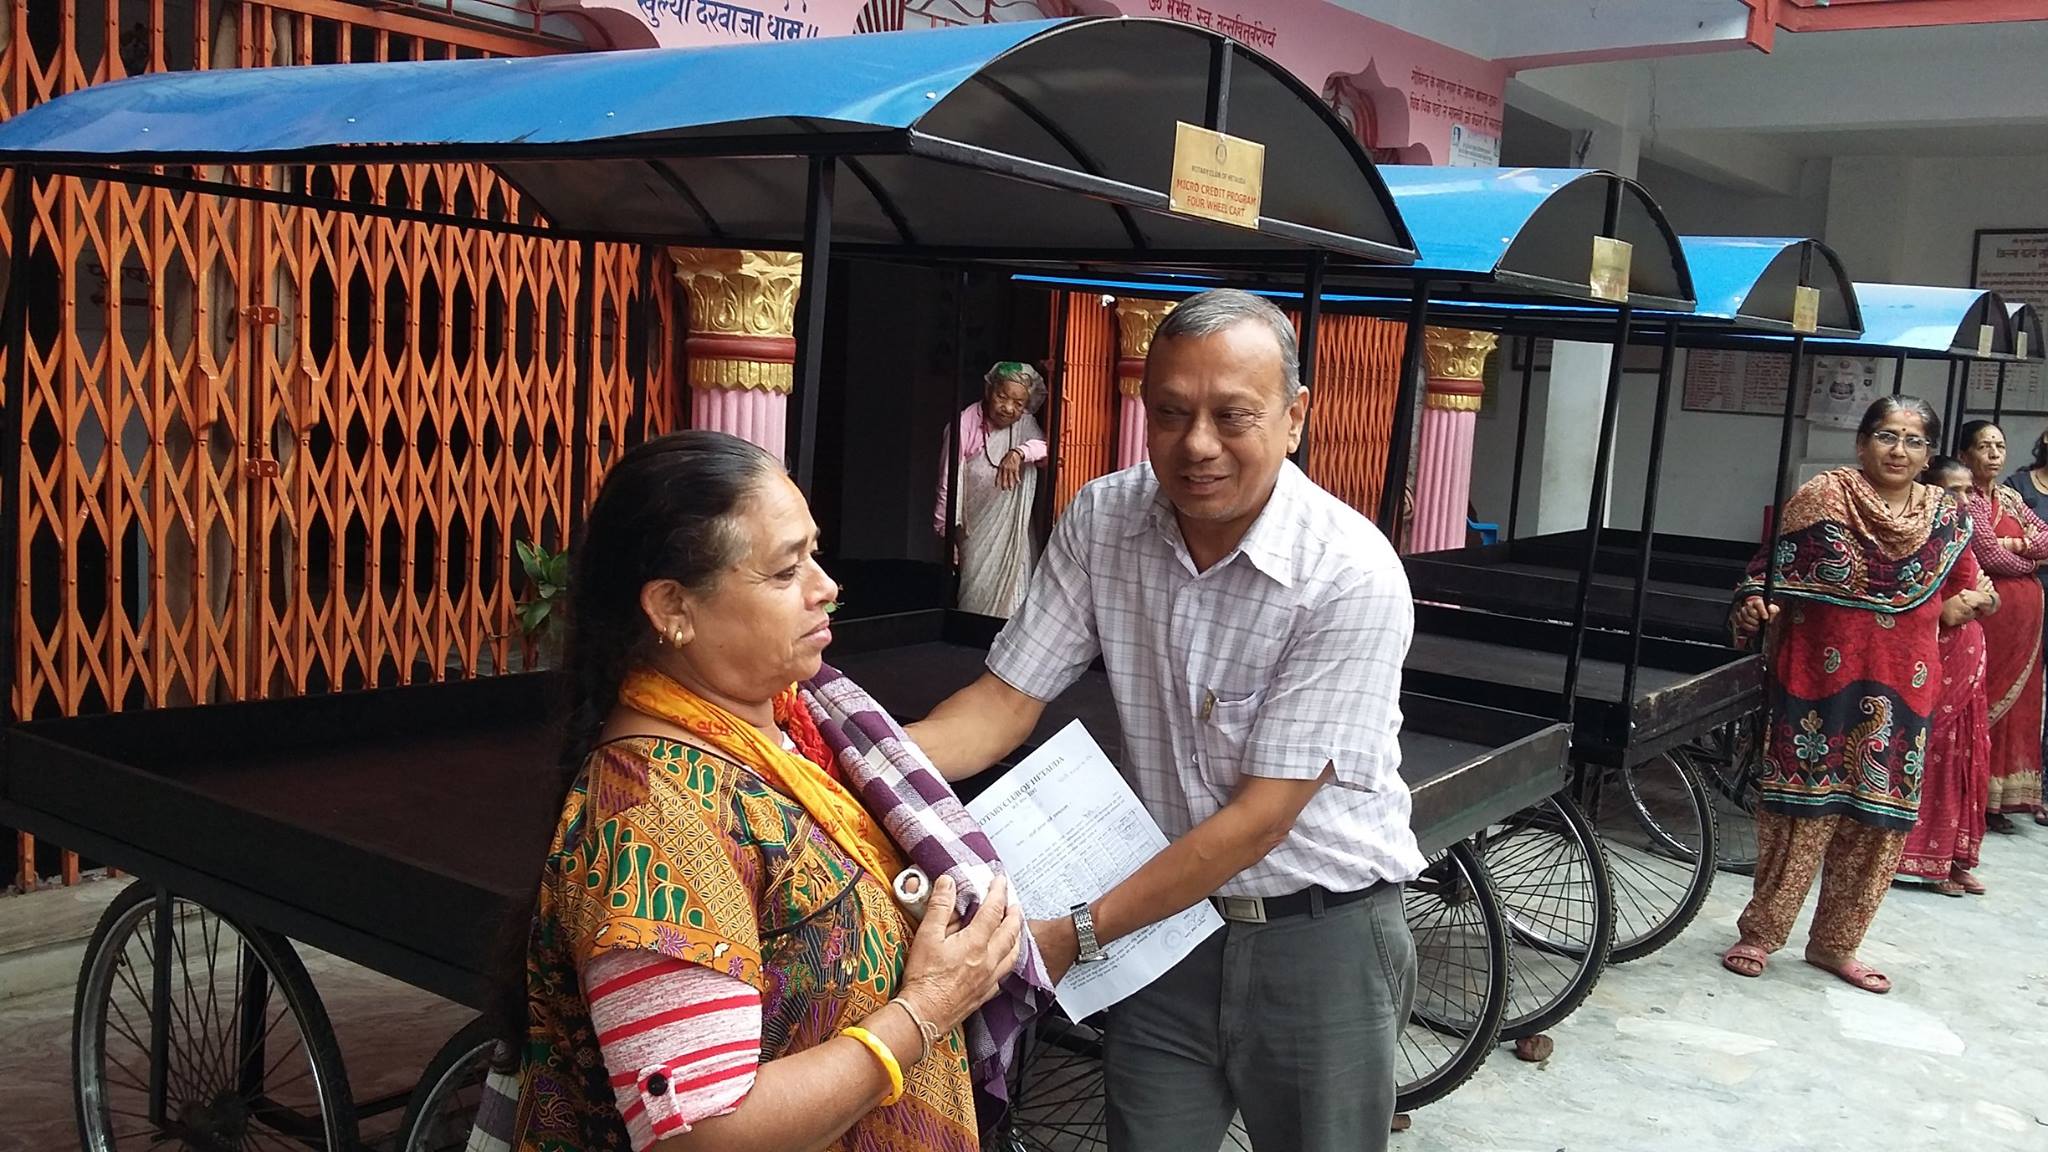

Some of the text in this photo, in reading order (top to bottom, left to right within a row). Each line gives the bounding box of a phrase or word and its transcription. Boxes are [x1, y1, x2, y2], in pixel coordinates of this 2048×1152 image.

[1176, 178, 1257, 206] MICRO CREDIT PROGRAM
[1187, 195, 1246, 217] FOUR WHEEL CART
[1019, 781, 1032, 794] OF
